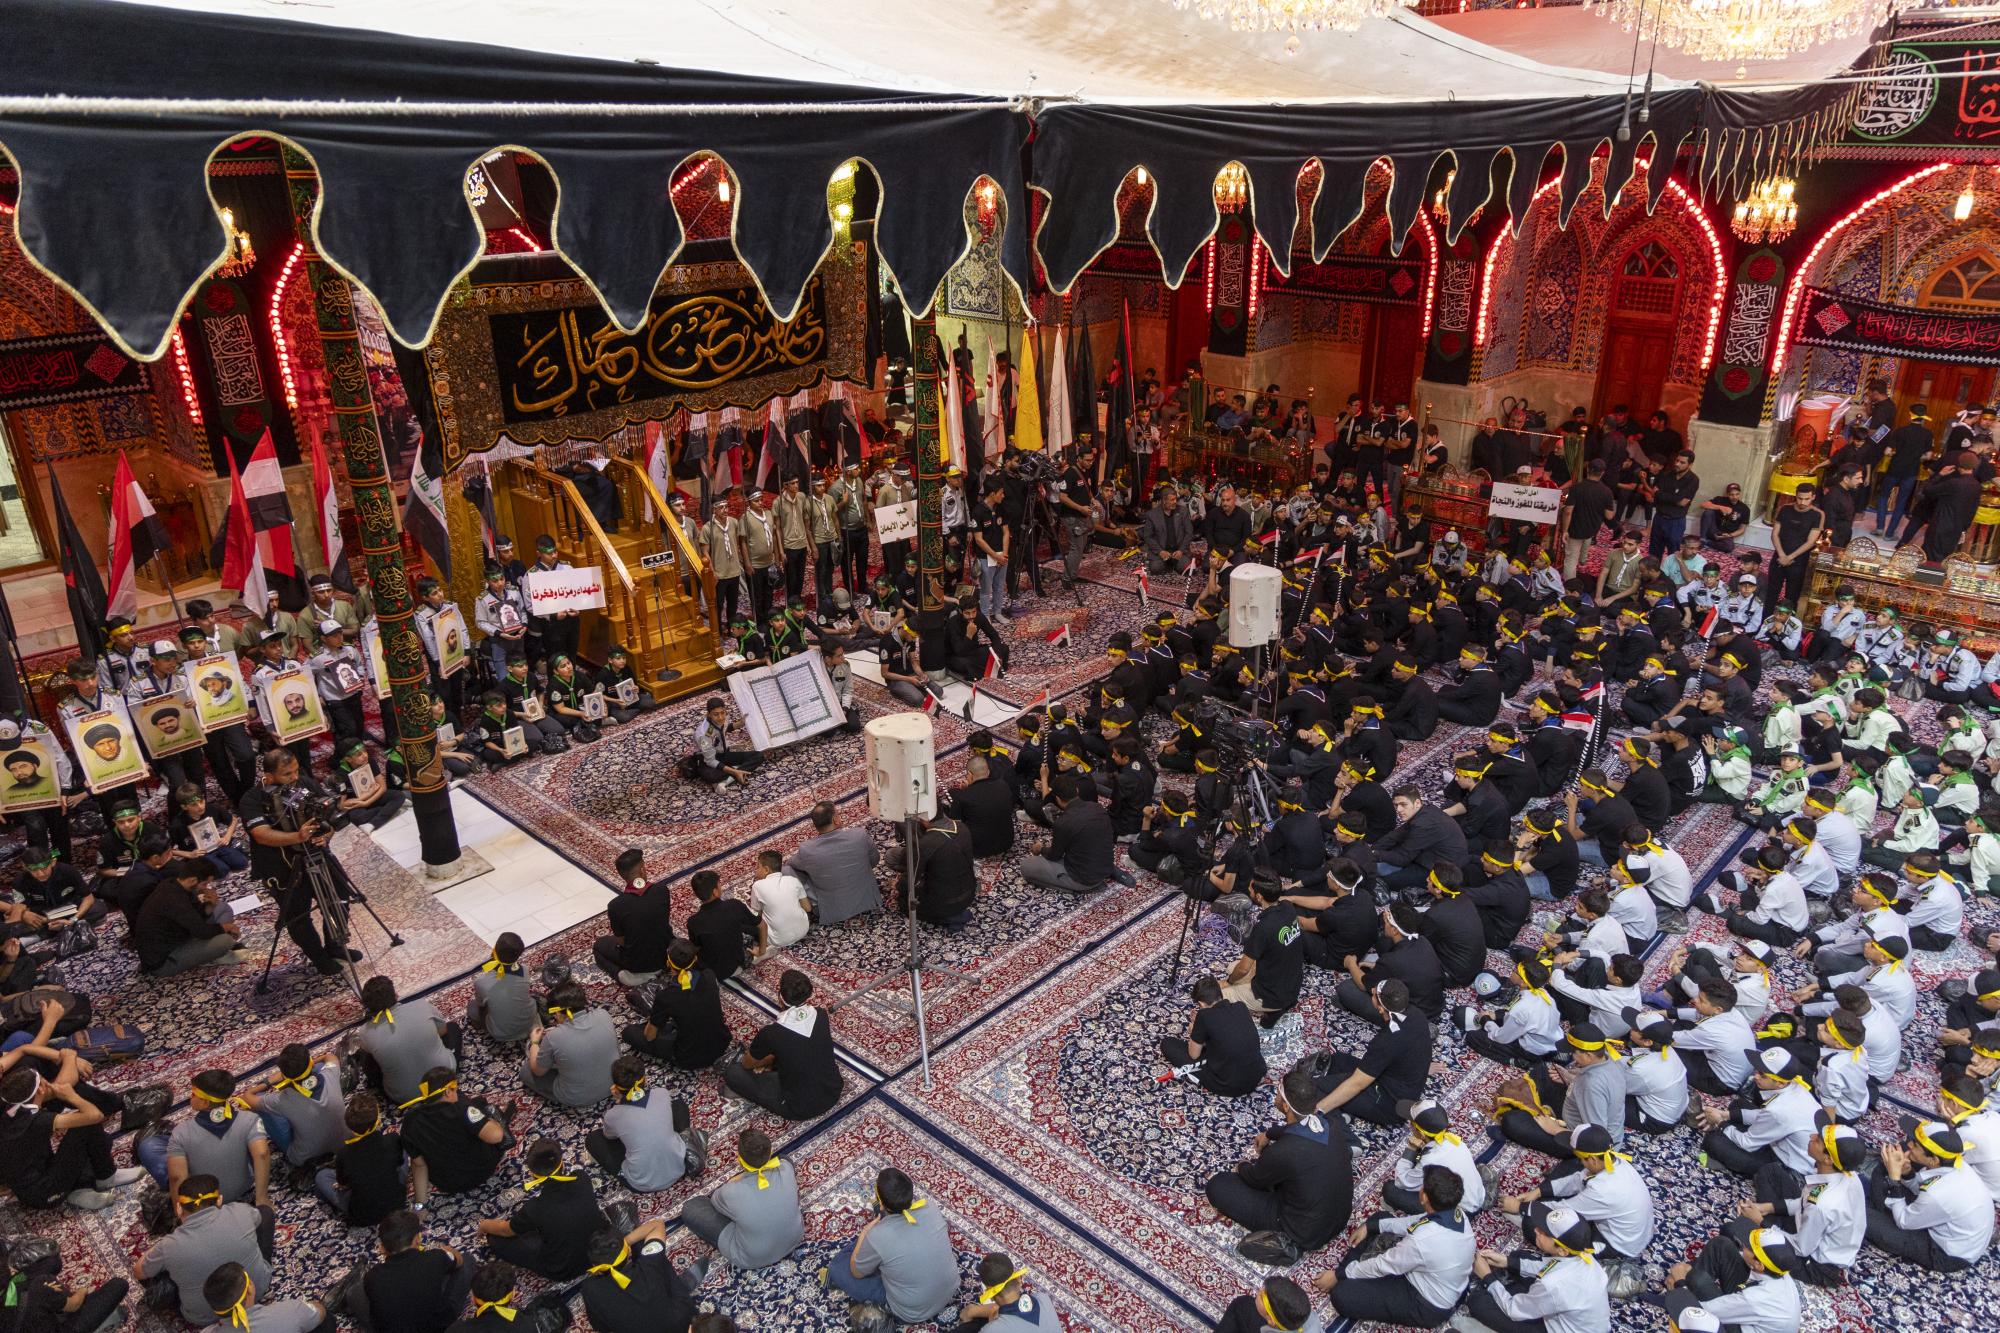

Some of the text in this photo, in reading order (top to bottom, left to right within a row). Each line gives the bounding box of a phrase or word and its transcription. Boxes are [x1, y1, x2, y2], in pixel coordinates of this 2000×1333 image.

[1491, 495, 1557, 512] طريقنا للفوز والنجاة
